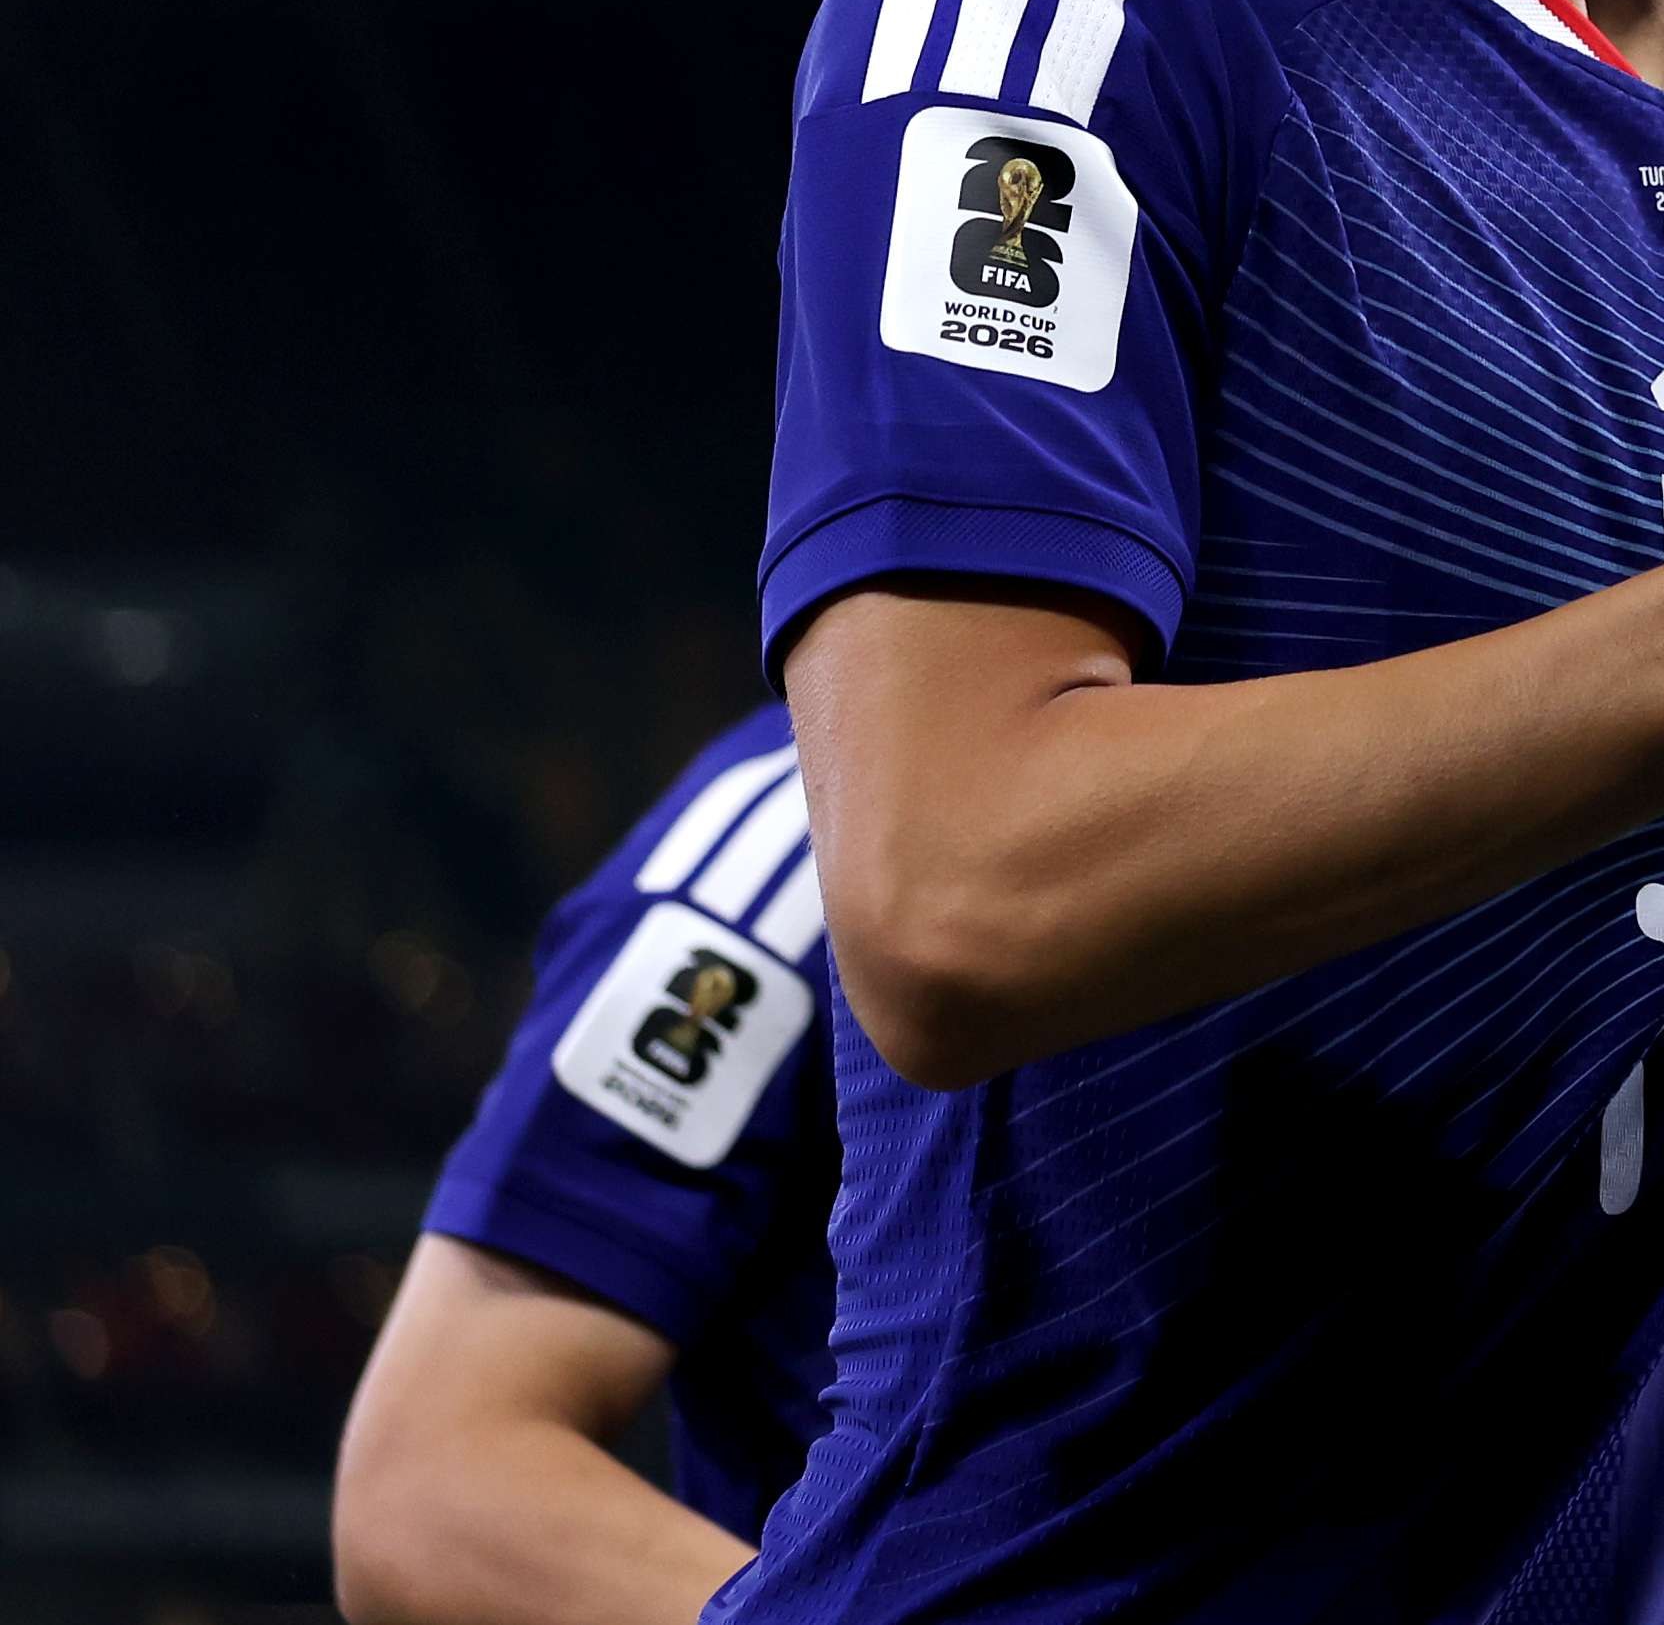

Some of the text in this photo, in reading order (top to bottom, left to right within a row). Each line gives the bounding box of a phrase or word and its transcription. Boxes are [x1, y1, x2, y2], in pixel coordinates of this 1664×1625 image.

[981, 264, 1032, 293] FIFA
[944, 301, 1056, 333] WORLD CUP
[940, 320, 1054, 359] 2026
